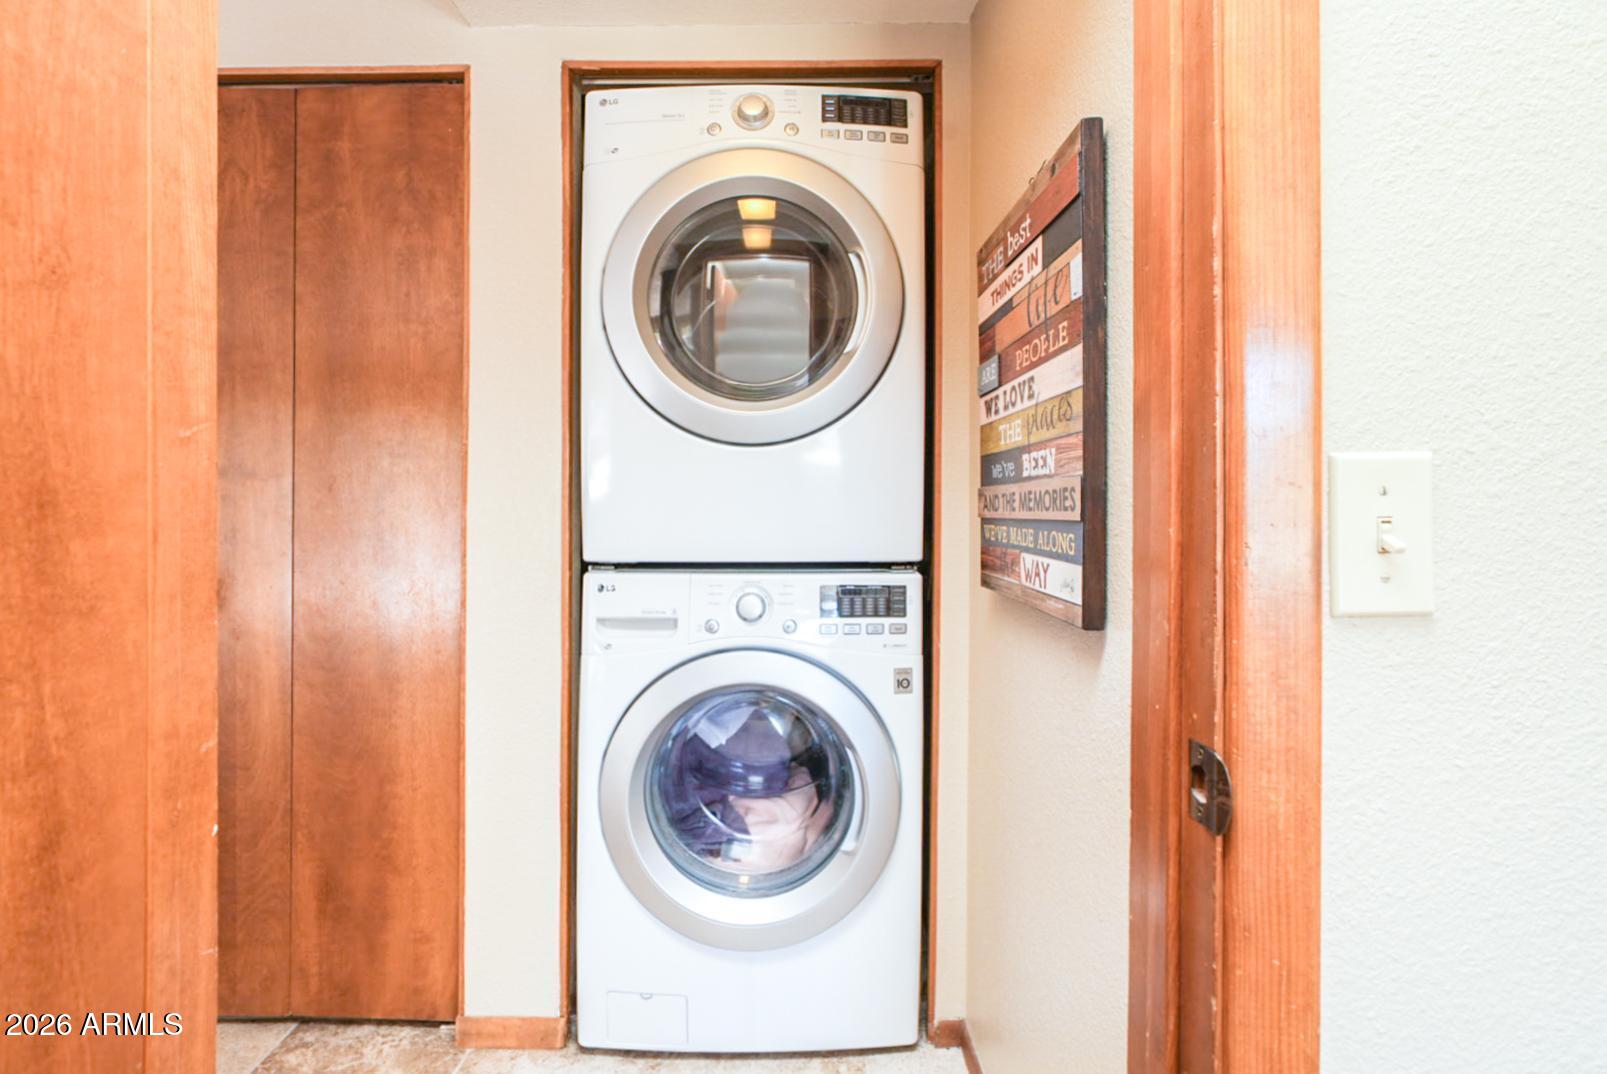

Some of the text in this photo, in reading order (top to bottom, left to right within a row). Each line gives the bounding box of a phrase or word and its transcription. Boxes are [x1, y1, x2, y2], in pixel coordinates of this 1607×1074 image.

[982, 213, 1032, 284] THE best
[990, 246, 1039, 306] THINGS IN
[981, 322, 1068, 385] ARE PEOPLE
[984, 394, 999, 418] WE
[999, 391, 1073, 449] THE places
[991, 448, 1055, 478] we've BEEN
[983, 487, 1076, 512] AND THE MEMORIES
[984, 524, 1075, 555] WE'VE MADE ALONG
[1022, 557, 1050, 589] WAY
